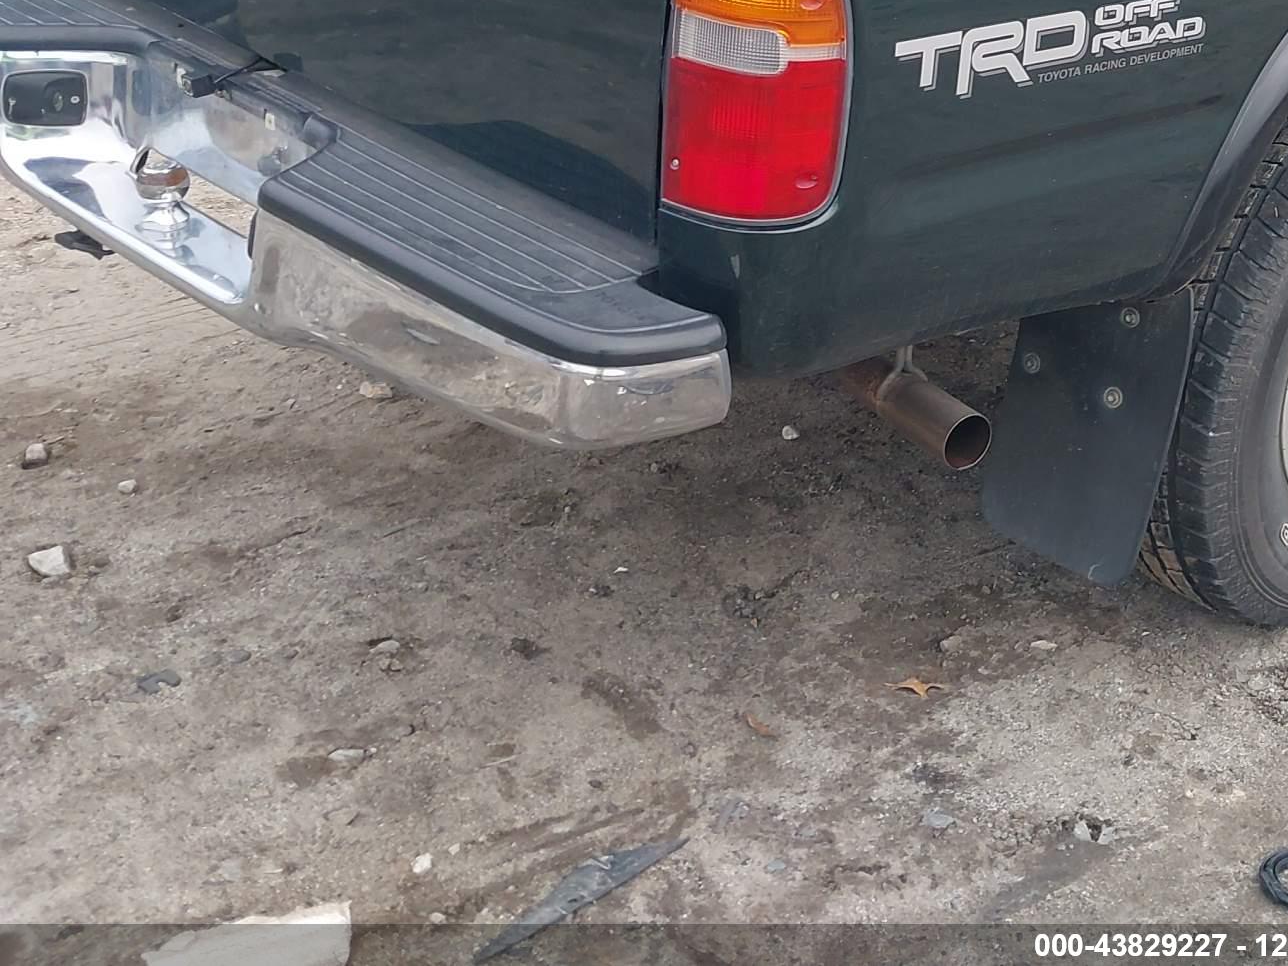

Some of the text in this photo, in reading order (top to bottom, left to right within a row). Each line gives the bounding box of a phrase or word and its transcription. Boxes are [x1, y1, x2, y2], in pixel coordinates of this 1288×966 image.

[895, 10, 1090, 99] TRD
[1091, 16, 1206, 58] ROAD
[1038, 43, 1204, 84] TOYOTA RACING DEVELOPMENT
